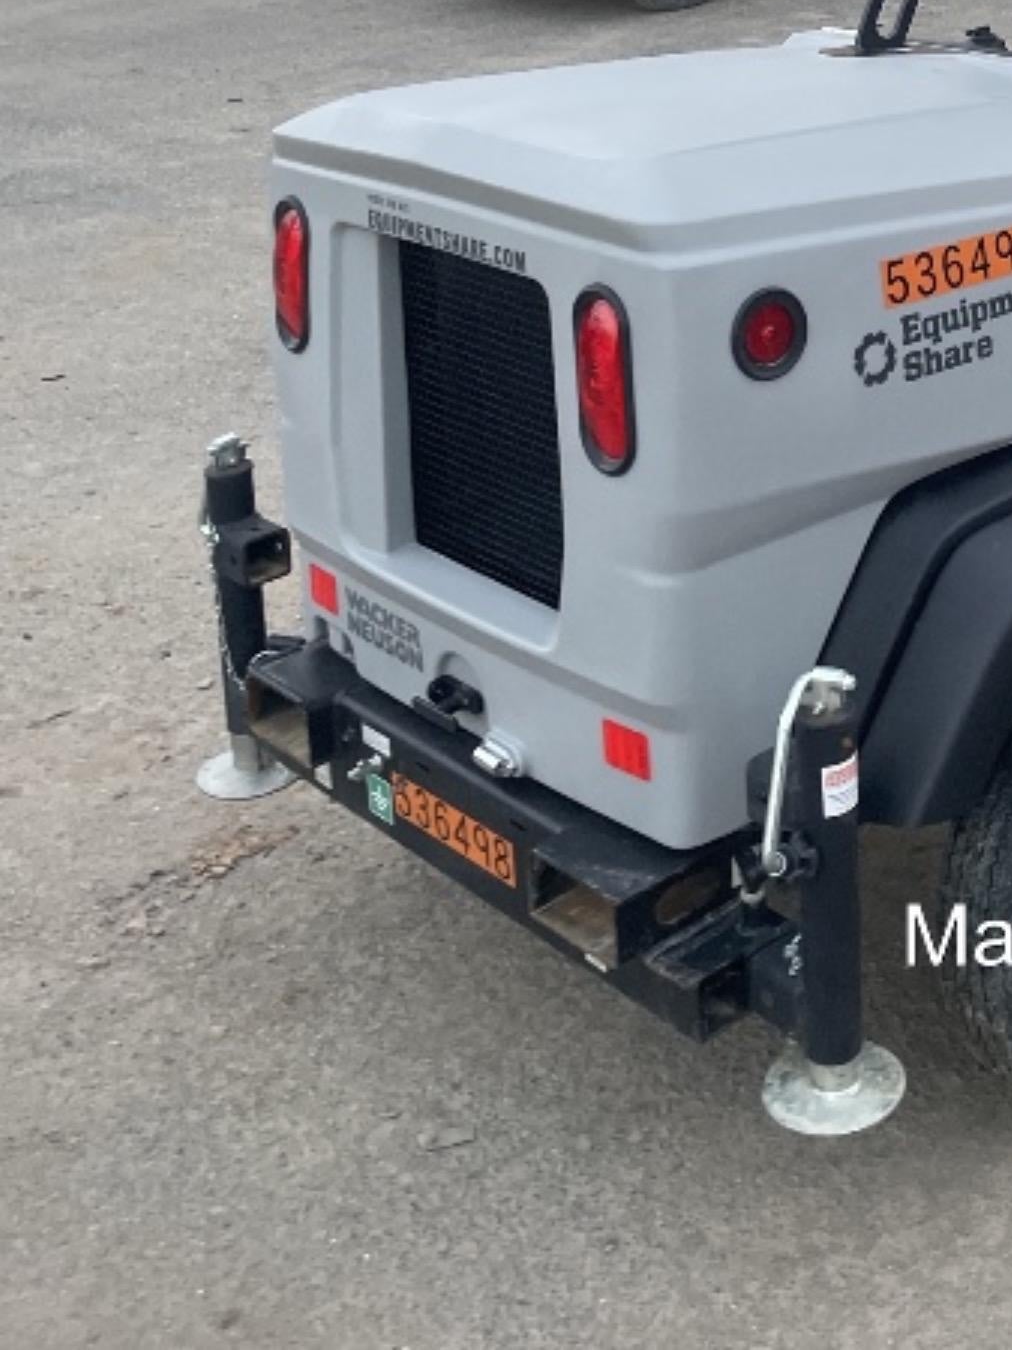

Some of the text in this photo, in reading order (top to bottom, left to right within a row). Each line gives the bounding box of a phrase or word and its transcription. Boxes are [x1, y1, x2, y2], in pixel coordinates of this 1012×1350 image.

[368, 209, 526, 272] EQUIPMENTSHARE.COM
[902, 335, 994, 382] Share
[344, 586, 420, 649] WACKER
[346, 611, 424, 673] NEUSON
[393, 776, 511, 880] 536498
